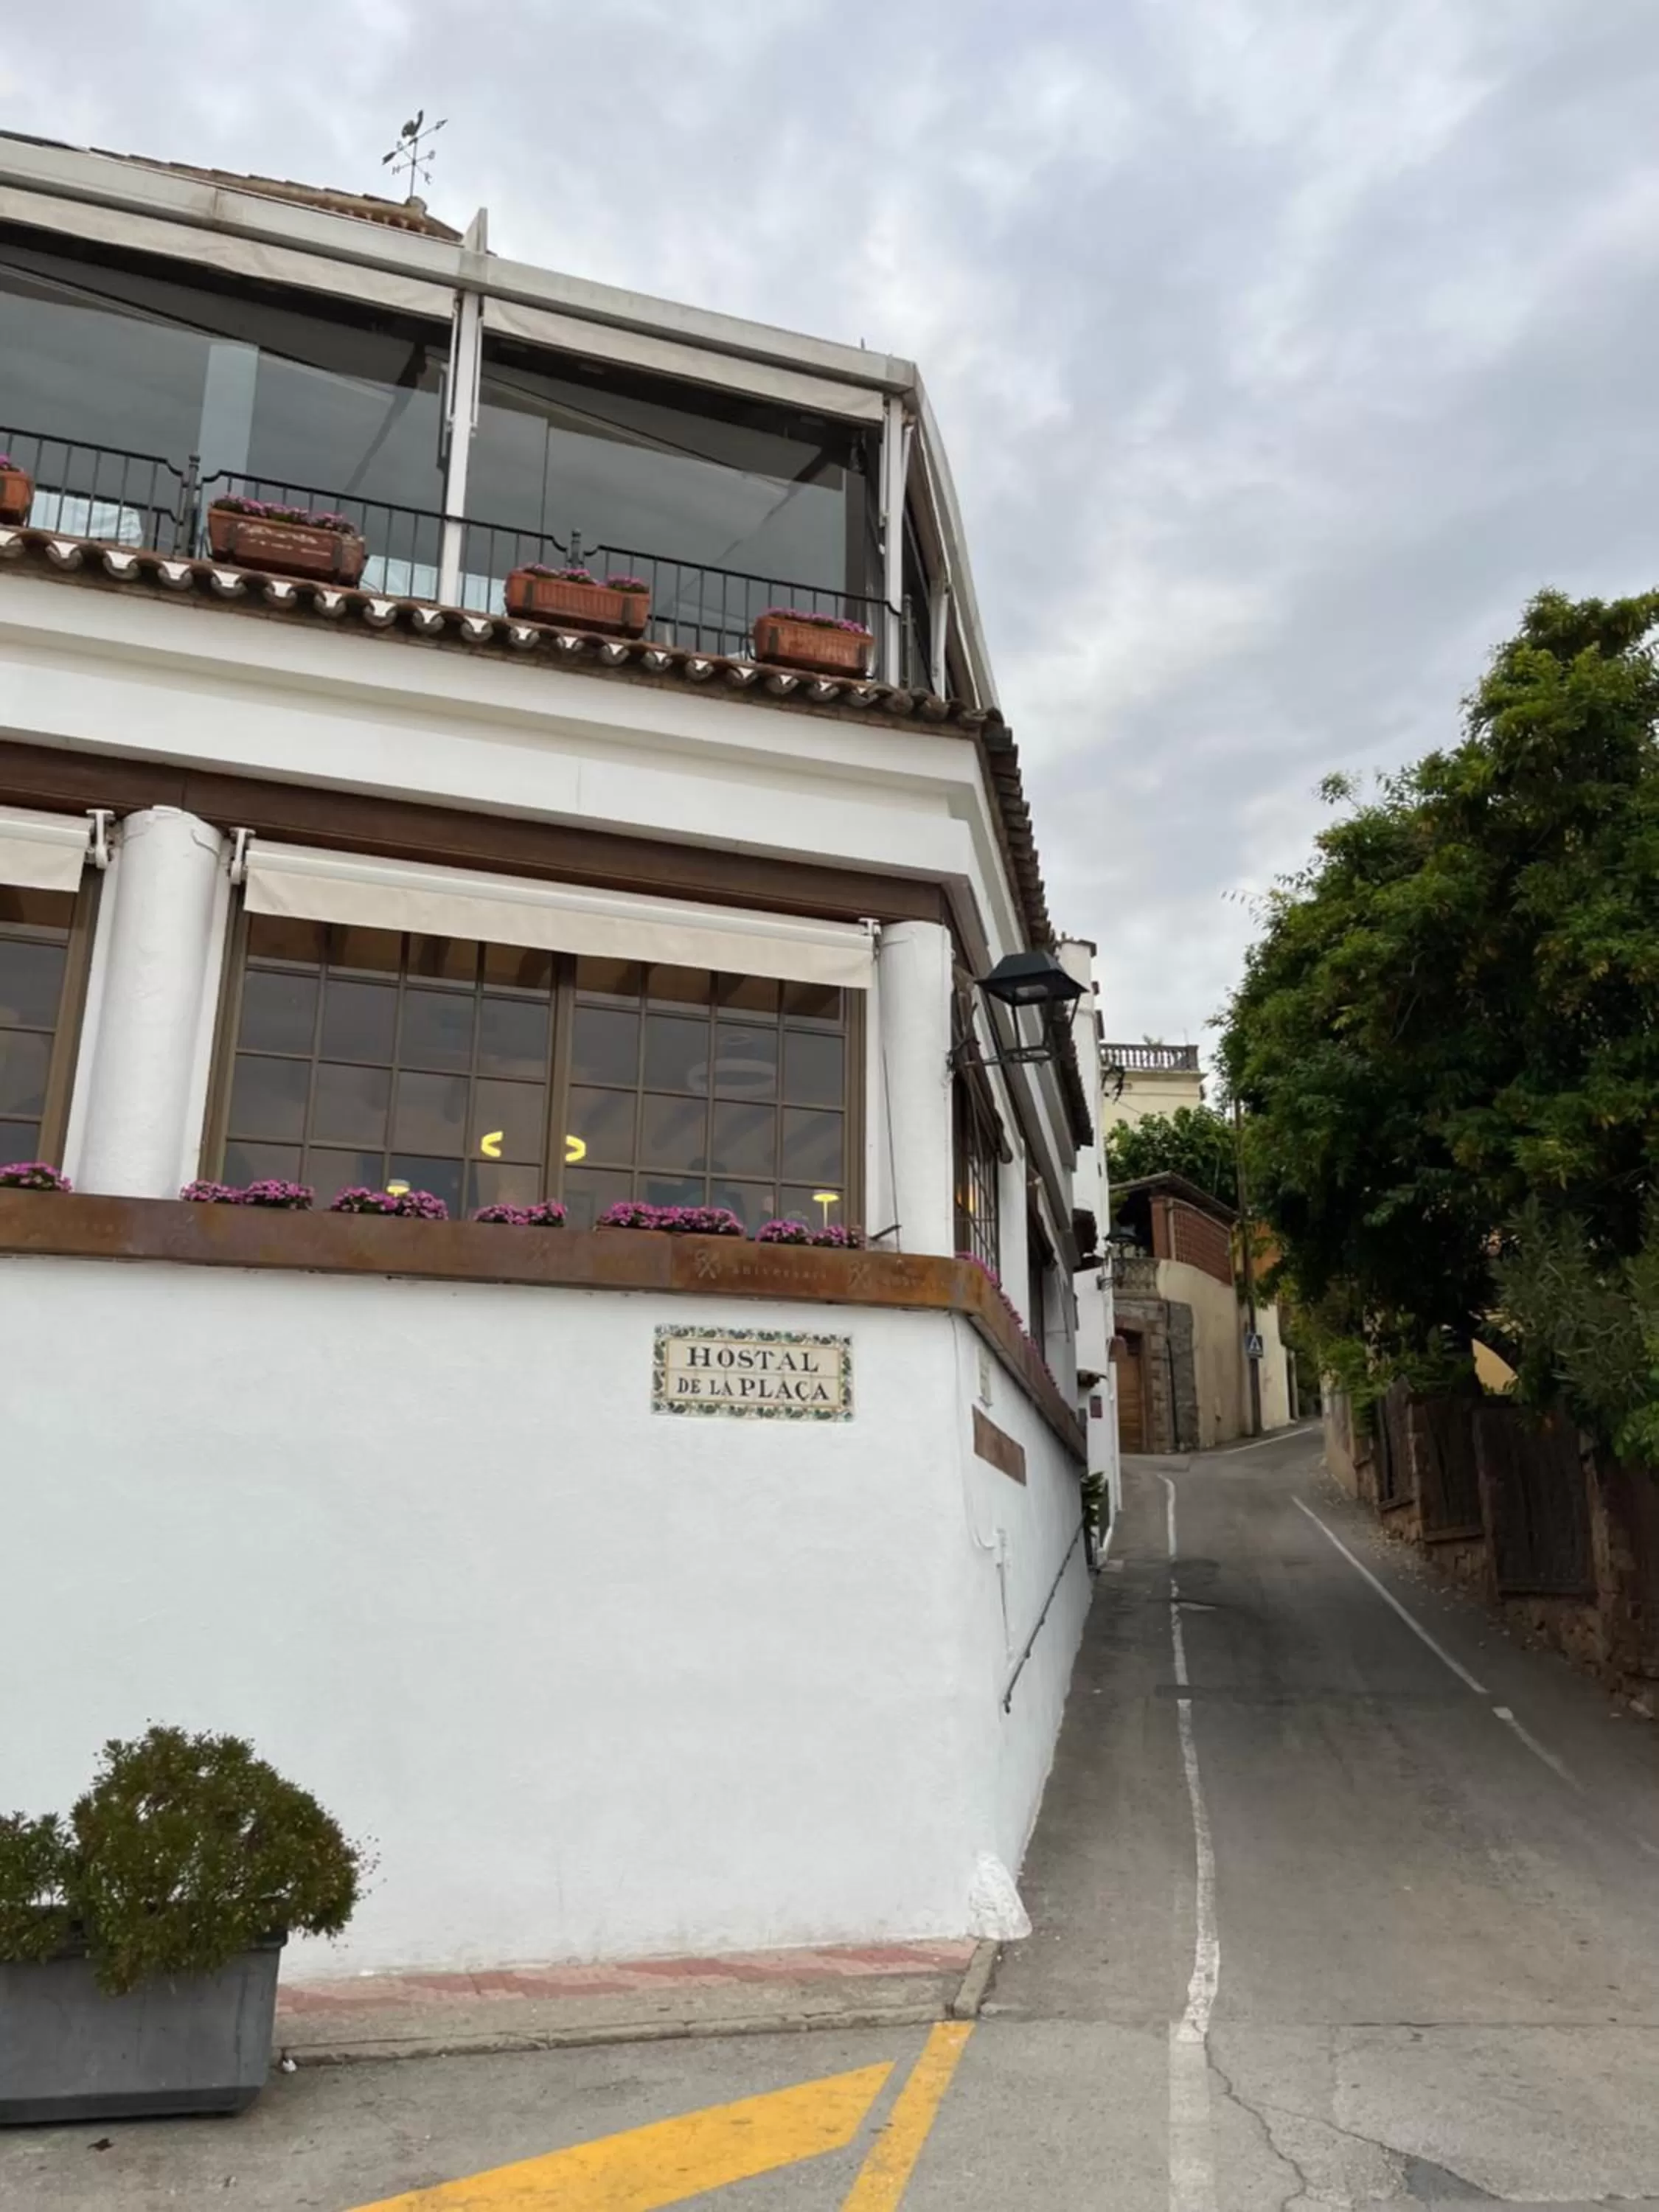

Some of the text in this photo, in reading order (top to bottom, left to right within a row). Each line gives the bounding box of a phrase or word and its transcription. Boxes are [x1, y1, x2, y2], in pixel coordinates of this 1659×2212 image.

[686, 1347, 819, 1372] HOSTAL
[677, 1377, 829, 1402] DE LA PLAÇA
